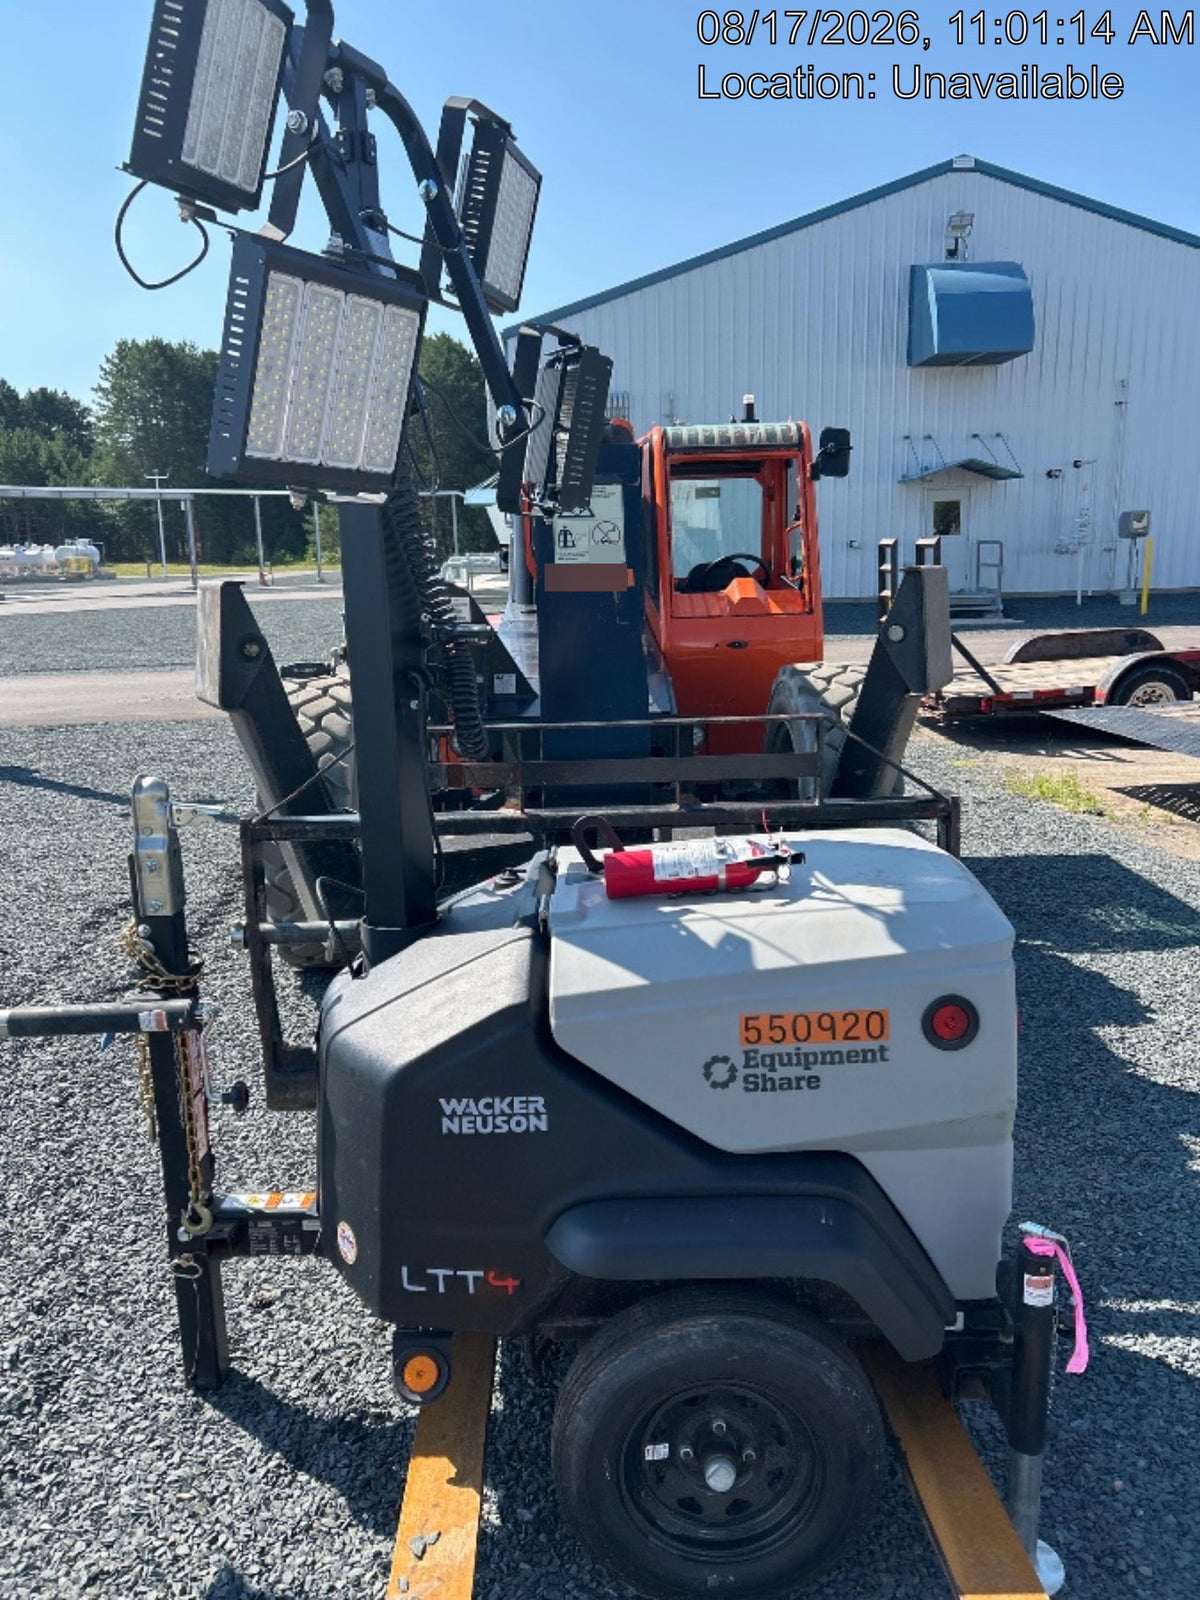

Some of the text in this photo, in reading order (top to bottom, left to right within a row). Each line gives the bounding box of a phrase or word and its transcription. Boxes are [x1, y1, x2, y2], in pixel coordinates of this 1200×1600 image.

[743, 1010, 887, 1044] 550920
[742, 1045, 890, 1072] Equipment
[742, 1073, 821, 1093] Share
[438, 1096, 547, 1116] WACKER
[441, 1114, 549, 1134] NEUSON
[401, 1265, 520, 1295] LTT4
